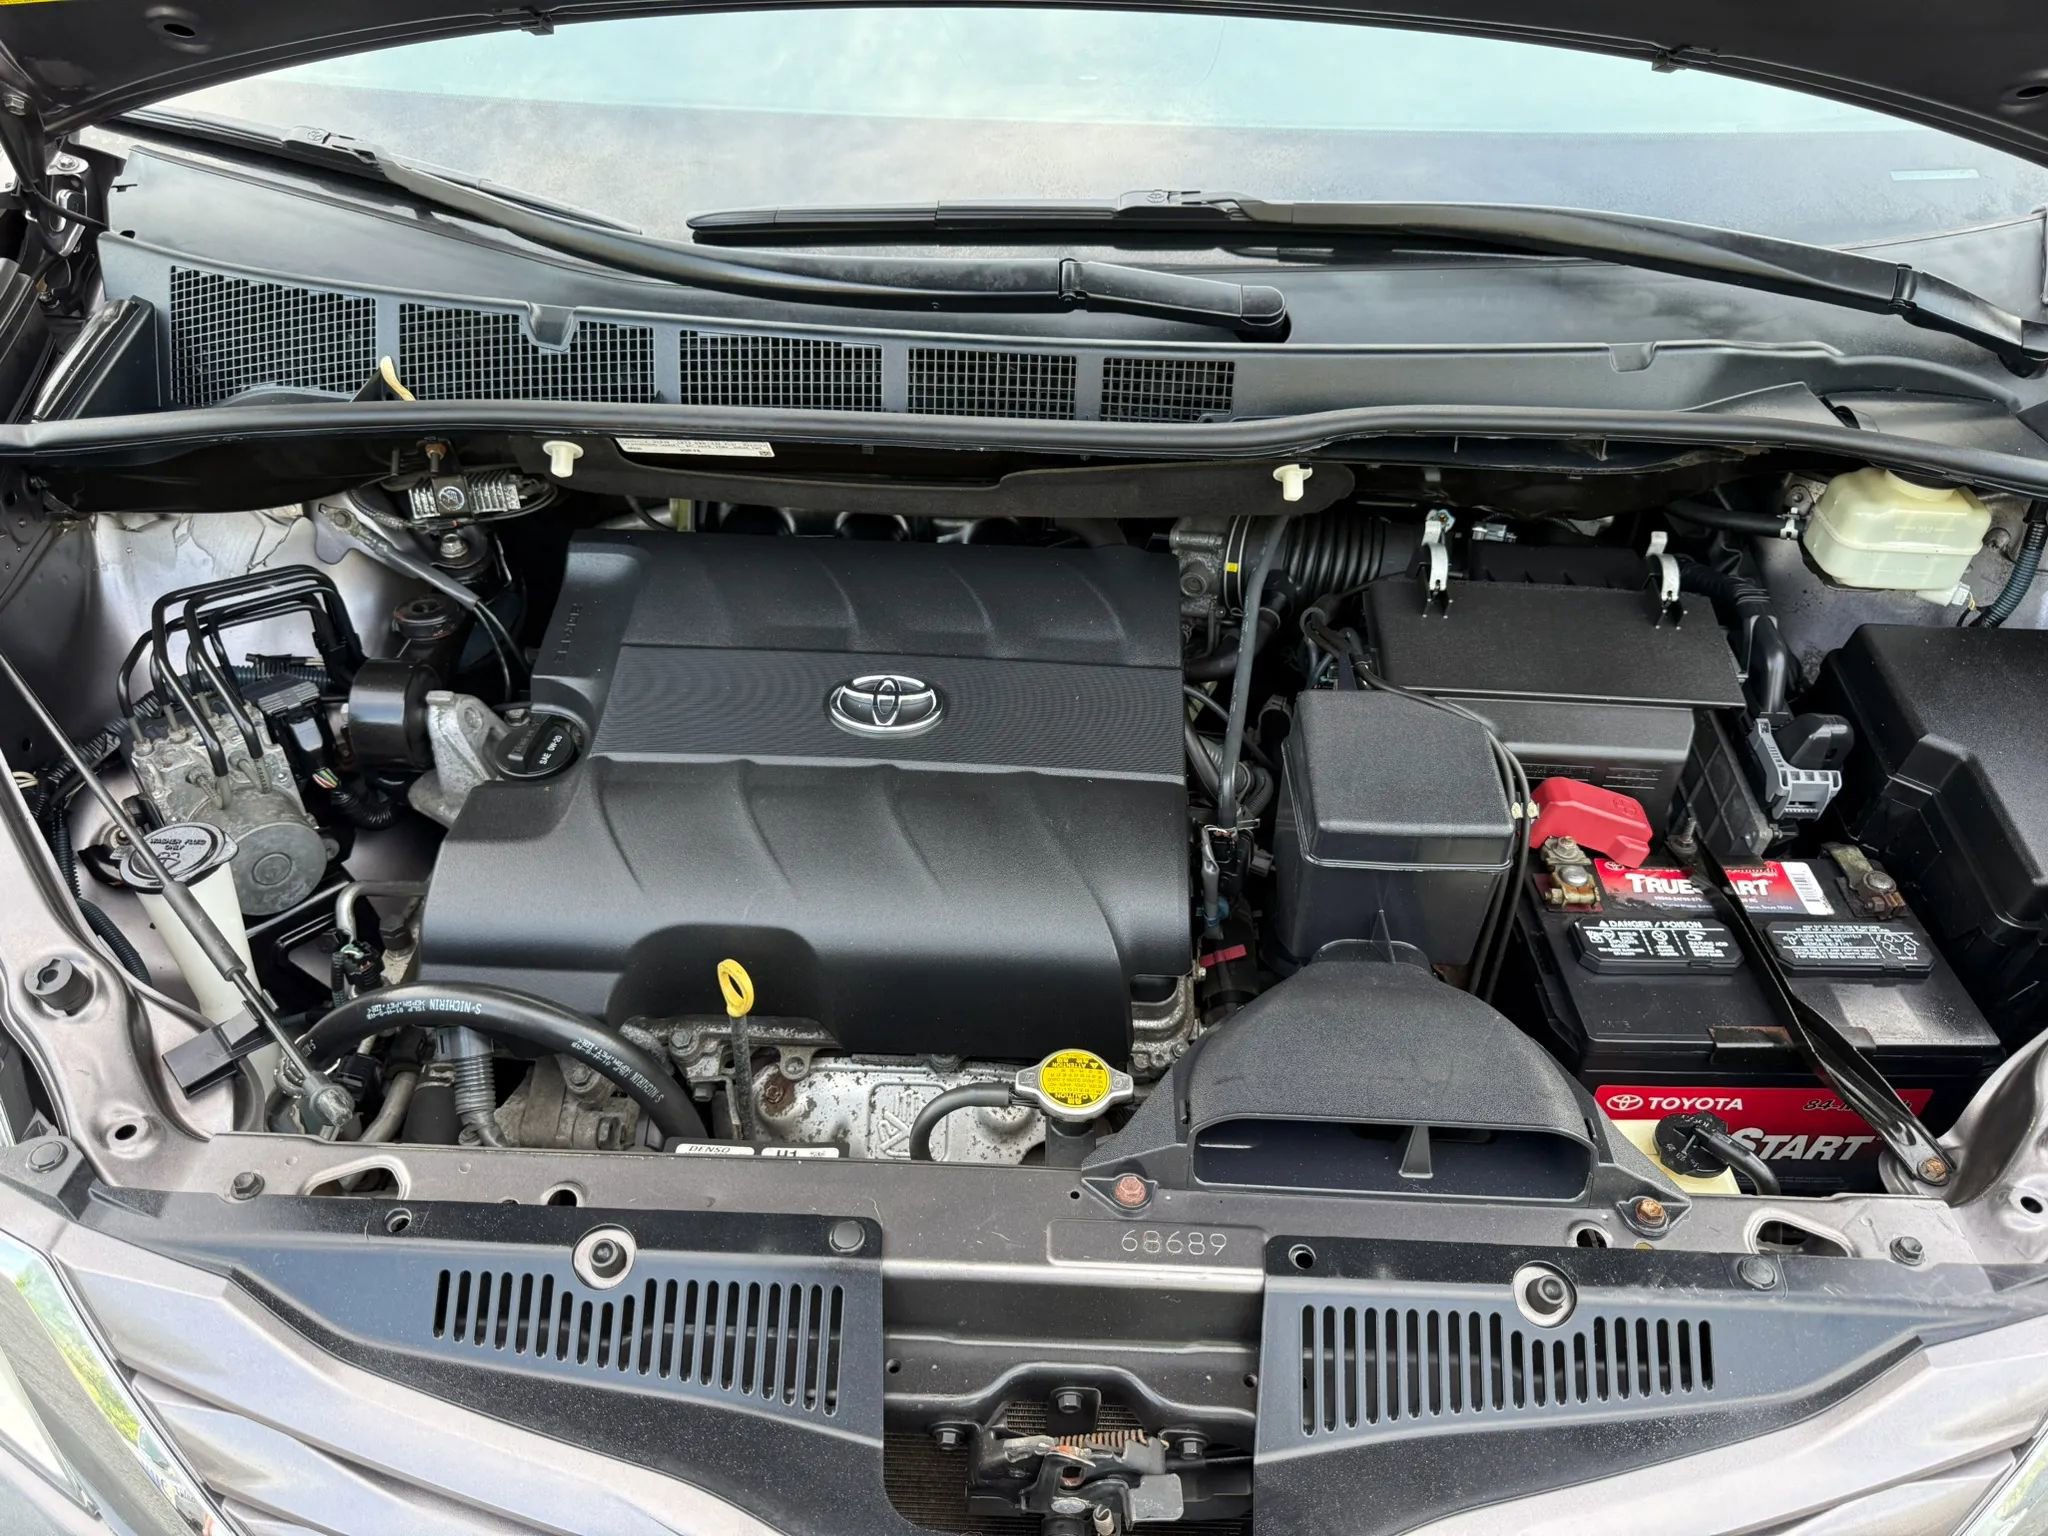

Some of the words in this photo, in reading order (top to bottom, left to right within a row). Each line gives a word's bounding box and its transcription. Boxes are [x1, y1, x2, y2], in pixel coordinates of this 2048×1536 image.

[1609, 920, 1653, 928] DANGER
[1662, 921, 1703, 929] POISON
[1649, 1097, 1743, 1110] TOYOTA
[688, 1145, 731, 1153] DENSO
[1121, 1229, 1227, 1256] 68689
